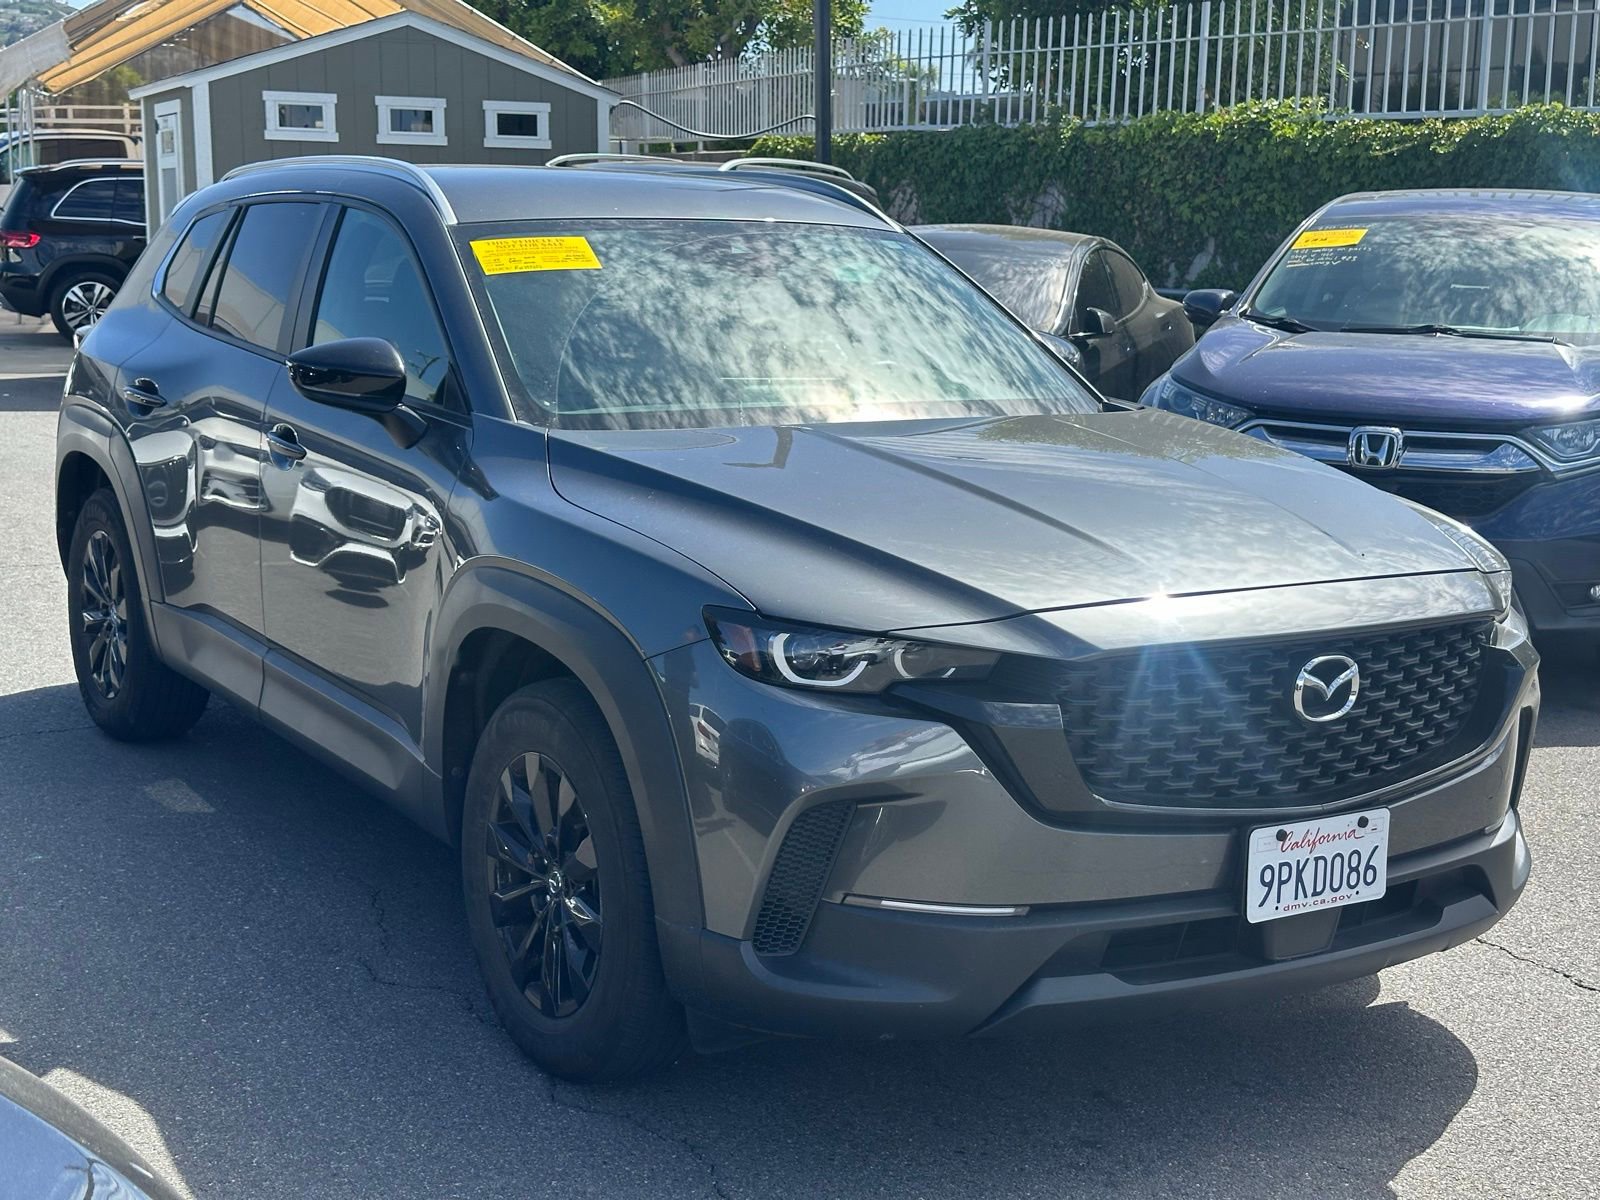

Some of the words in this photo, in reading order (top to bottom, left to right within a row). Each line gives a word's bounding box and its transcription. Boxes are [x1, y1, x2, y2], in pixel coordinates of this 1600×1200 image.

[1280, 826, 1364, 854] California
[1258, 845, 1380, 907] 9PKD086
[1283, 893, 1353, 912] dmv.ca.gov
